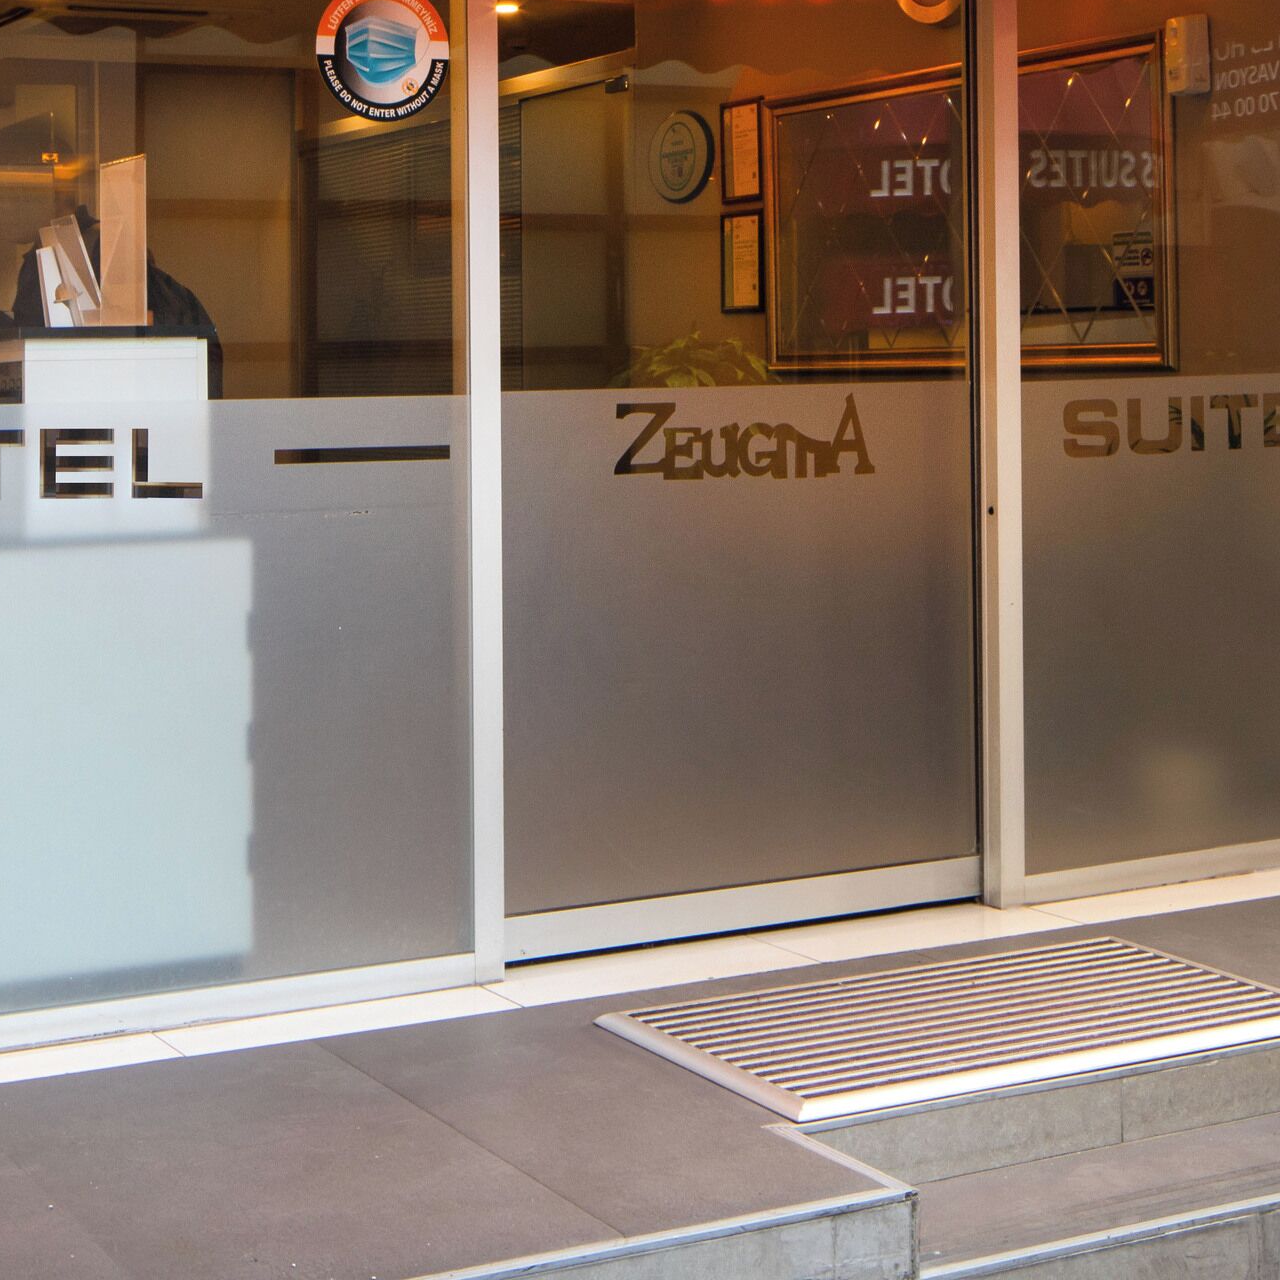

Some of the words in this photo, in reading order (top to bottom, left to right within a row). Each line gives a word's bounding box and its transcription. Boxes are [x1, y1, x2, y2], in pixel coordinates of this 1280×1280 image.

[324, 59, 343, 92] PLEASE
[430, 61, 445, 87] MASK
[339, 90, 352, 103] DO
[427, 85, 436, 94] A
[350, 98, 368, 113] NOT
[396, 91, 429, 117] WITHOUT
[368, 107, 396, 118] ENTER
